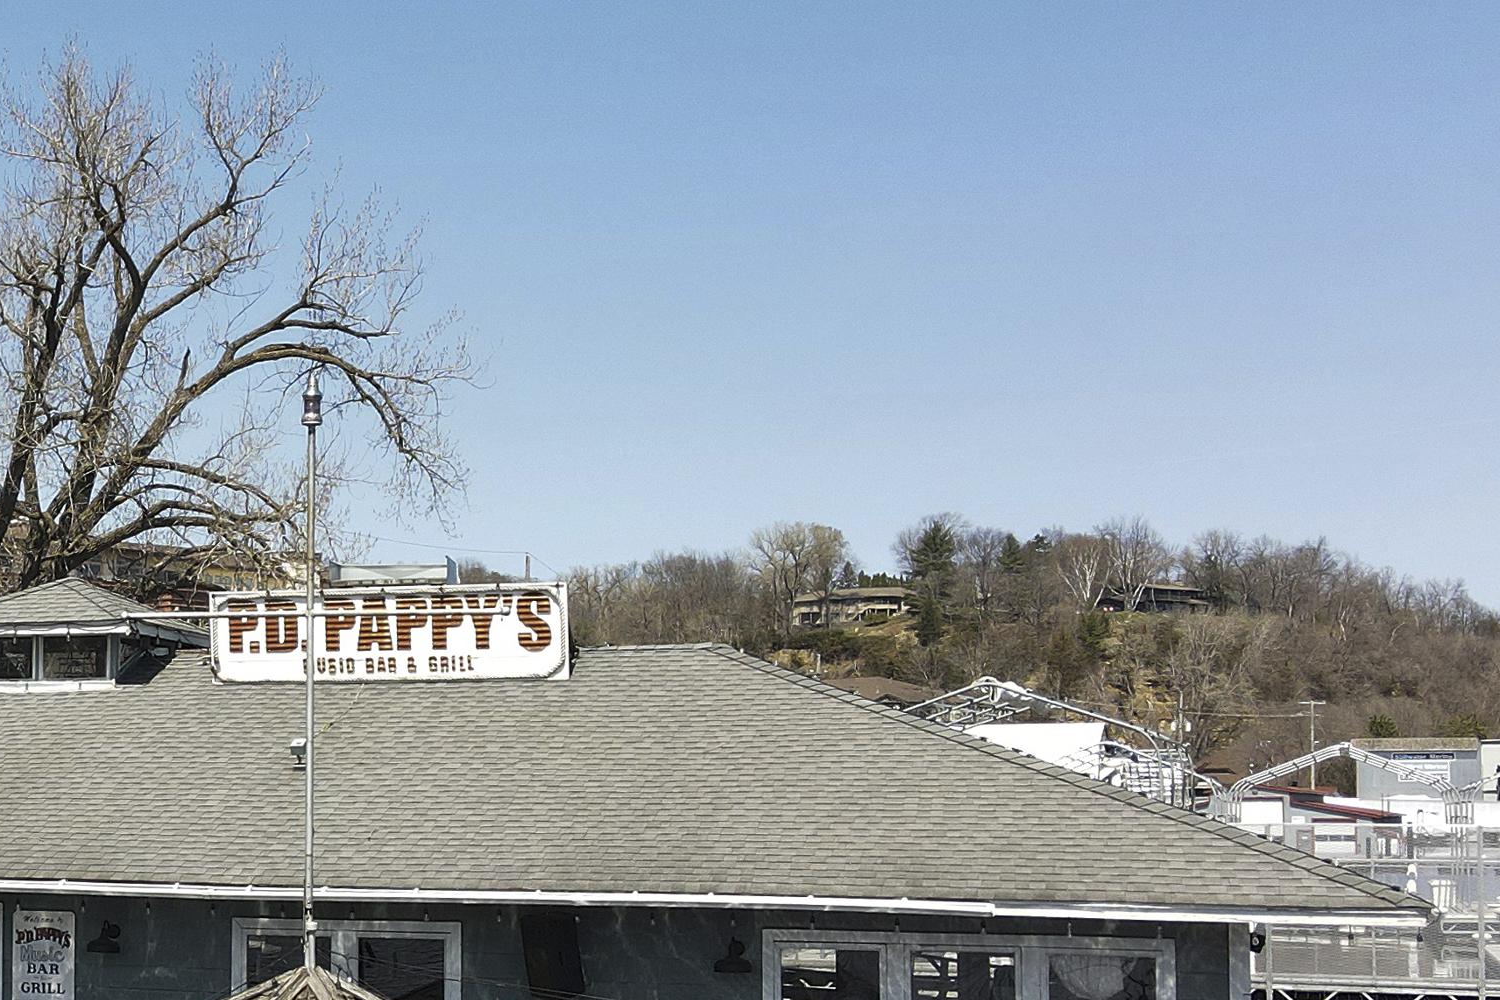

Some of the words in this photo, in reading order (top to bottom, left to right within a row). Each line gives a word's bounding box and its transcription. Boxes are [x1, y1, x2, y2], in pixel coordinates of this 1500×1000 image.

[323, 591, 552, 653] PAPPY'S
[365, 657, 397, 674] BAR
[407, 656, 417, 673] &
[428, 654, 475, 673] GRILL
[27, 963, 60, 975] BAR
[20, 981, 66, 995] GRILL
